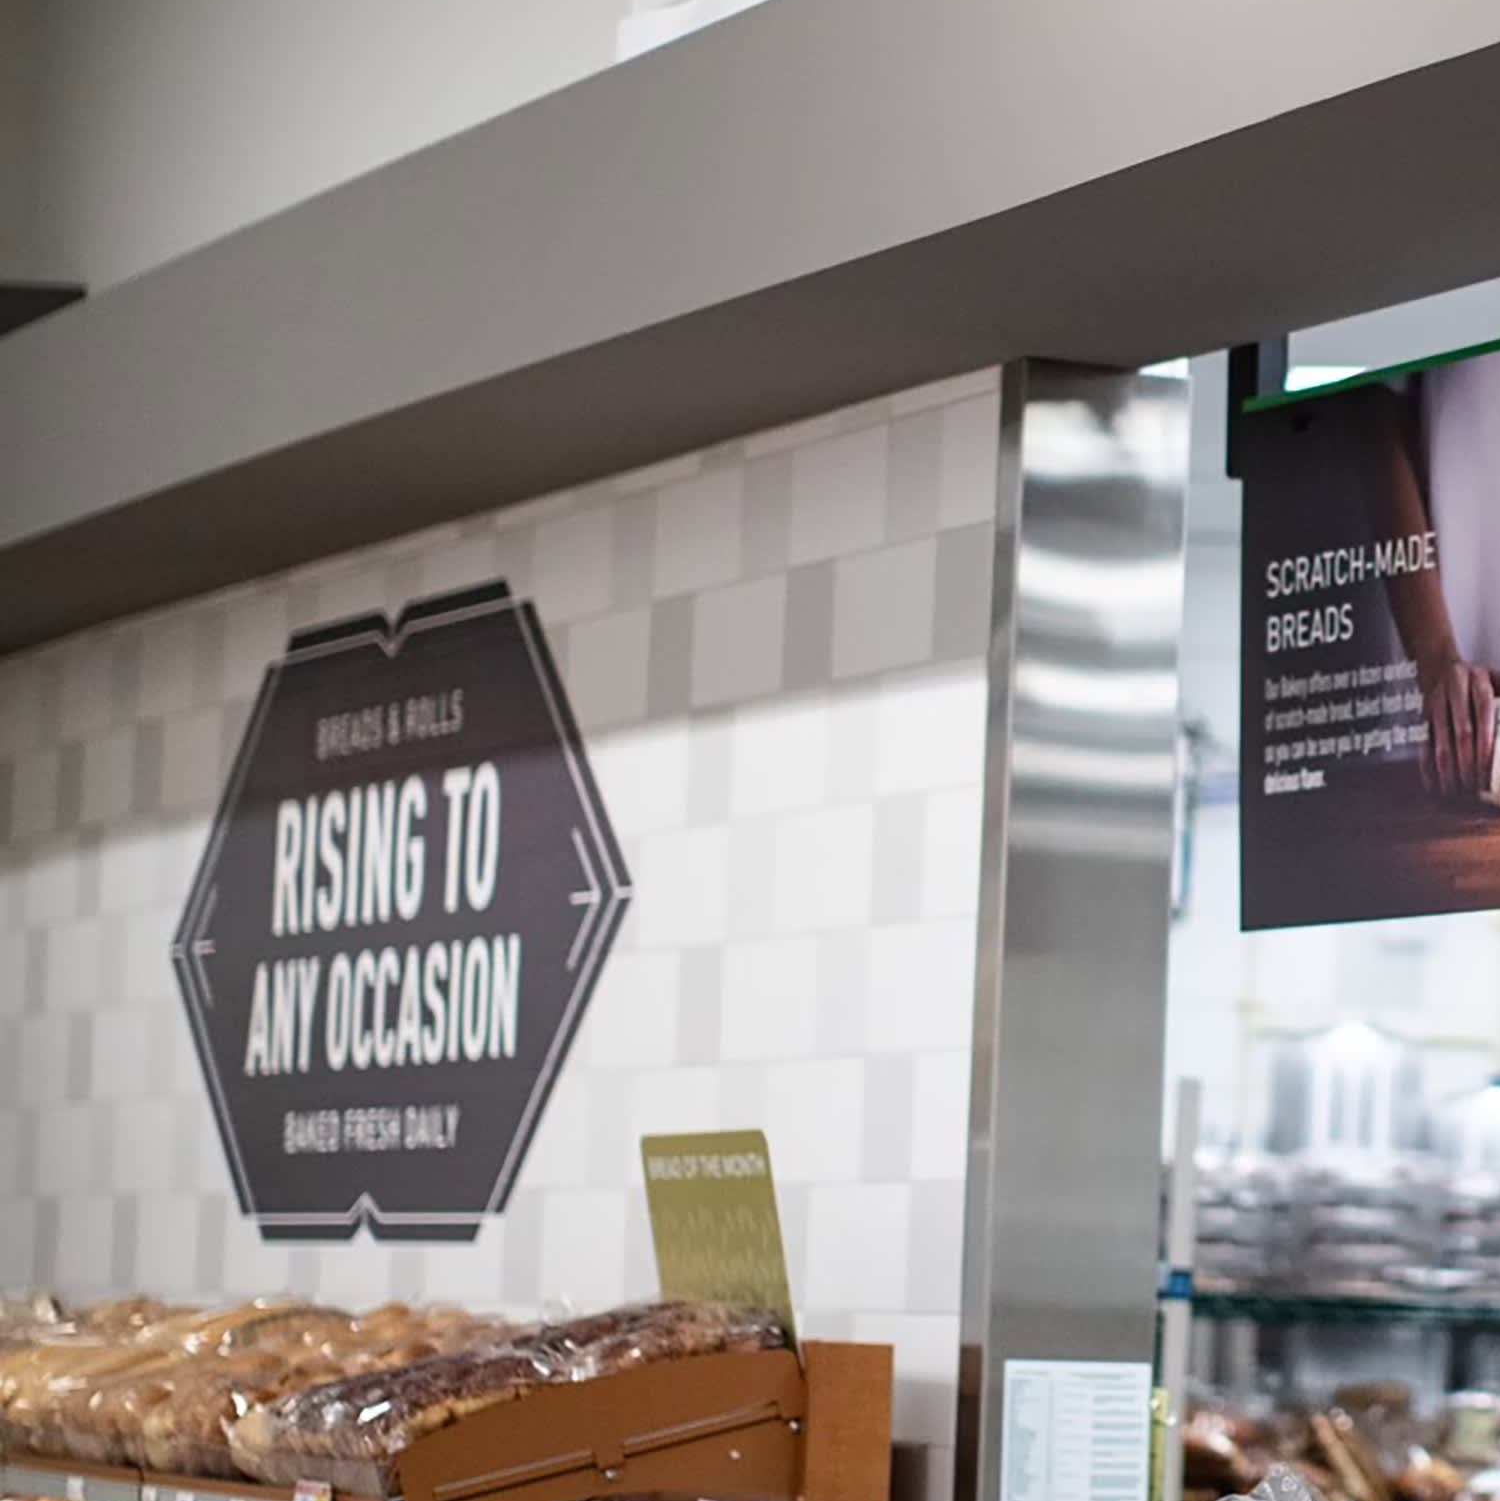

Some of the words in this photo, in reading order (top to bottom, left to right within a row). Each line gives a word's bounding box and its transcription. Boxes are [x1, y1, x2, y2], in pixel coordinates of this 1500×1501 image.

[1265, 531, 1436, 598] SCRATCH-MADE
[1266, 603, 1354, 653] BREADS
[272, 774, 427, 937] RISING
[442, 761, 501, 914] TO
[243, 960, 325, 1077] ANY
[325, 933, 521, 1071] OCCASION
[283, 1109, 340, 1155] BAKED
[403, 1103, 460, 1152] DAILY
